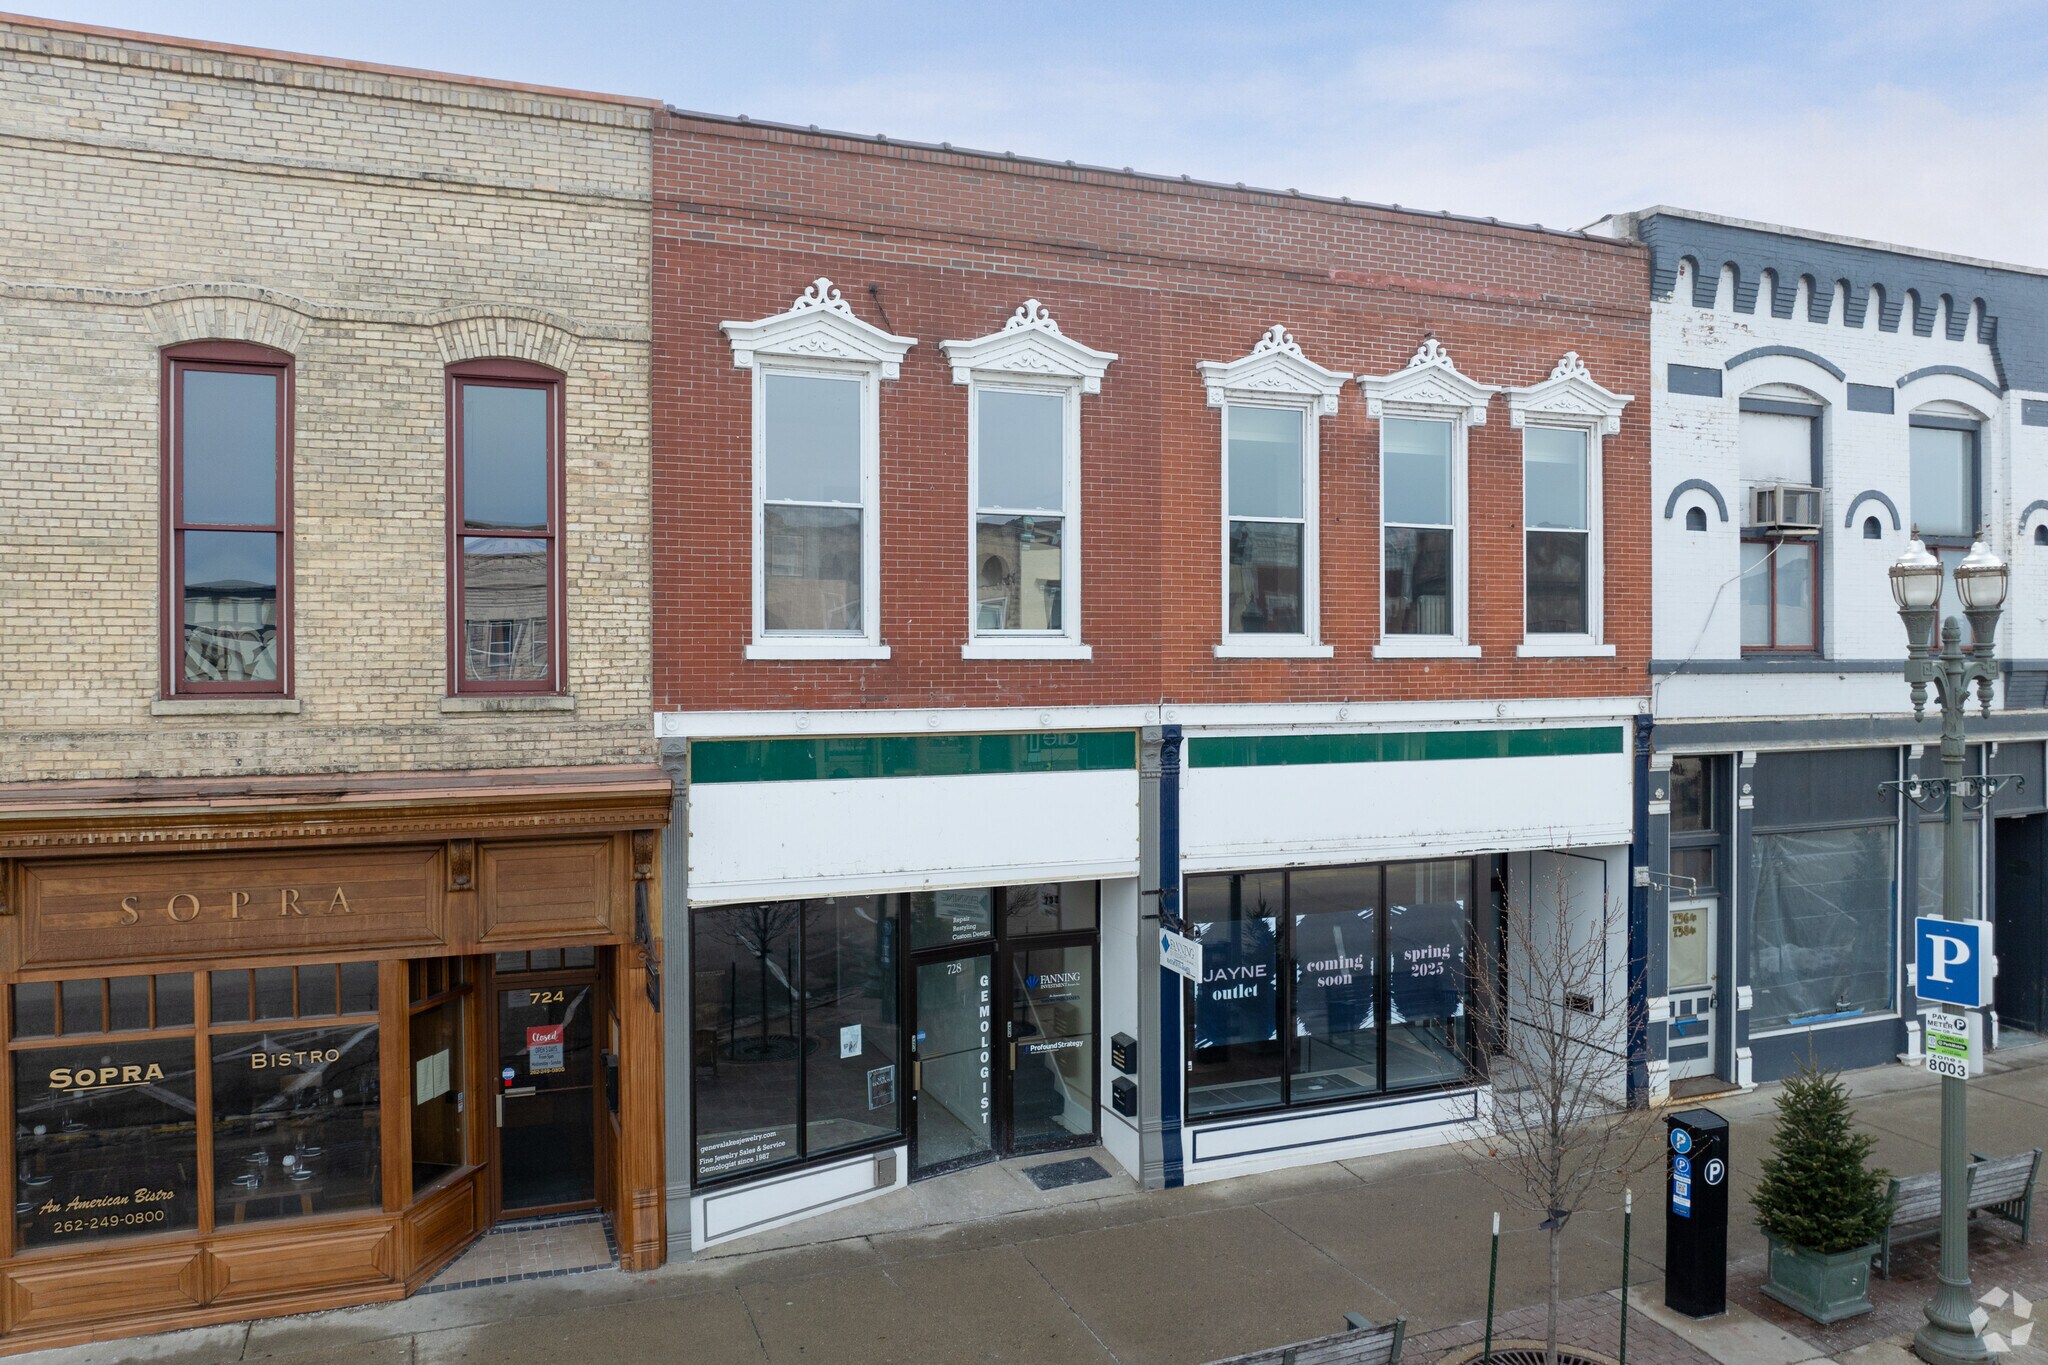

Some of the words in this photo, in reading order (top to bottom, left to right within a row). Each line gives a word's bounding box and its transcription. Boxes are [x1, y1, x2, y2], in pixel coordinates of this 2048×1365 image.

[120, 886, 355, 926] SOPRA
[952, 915, 970, 924] Repair
[952, 923, 977, 932] Restyling
[952, 932, 972, 941] Custom
[972, 929, 991, 939] Design
[1404, 943, 1451, 962] spring
[1925, 933, 1970, 983] P
[947, 963, 962, 975] 728
[1306, 954, 1364, 973] coming
[1411, 962, 1444, 978] 2025
[1040, 972, 1081, 985] FANNING
[1203, 964, 1267, 982] JAYNE
[1317, 973, 1353, 988] soon
[529, 990, 565, 1005] 724
[1212, 983, 1258, 1001] outlet
[1927, 1020, 1953, 1030] METER
[1932, 1013, 1948, 1021] PAY
[532, 1030, 559, 1043] Closed
[1940, 1034, 1965, 1044] DOWNLOAD
[979, 975, 990, 1124] GEMOLOGIST
[1030, 1042, 1058, 1052] Profound
[1058, 1040, 1084, 1048] Strategy
[251, 1049, 340, 1069] BISTRO
[1931, 1053, 1956, 1063] zone
[49, 1063, 165, 1089] SOPRA
[1929, 1059, 1966, 1077] 8003
[700, 1131, 777, 1154] genevalakesjewelry.com
[699, 1157, 714, 1166] Fine
[714, 1151, 738, 1163] Jewelry
[739, 1148, 756, 1157] Sales
[762, 1140, 786, 1151] Service
[699, 1160, 737, 1174] Gemologist
[737, 1157, 754, 1166] since
[755, 1152, 770, 1162] 1987
[1709, 1162, 1720, 1182] P
[39, 1198, 61, 1215] An
[65, 1195, 130, 1212] American
[134, 1187, 176, 1204] Bistro
[53, 1210, 165, 1234] 262-249-0800
